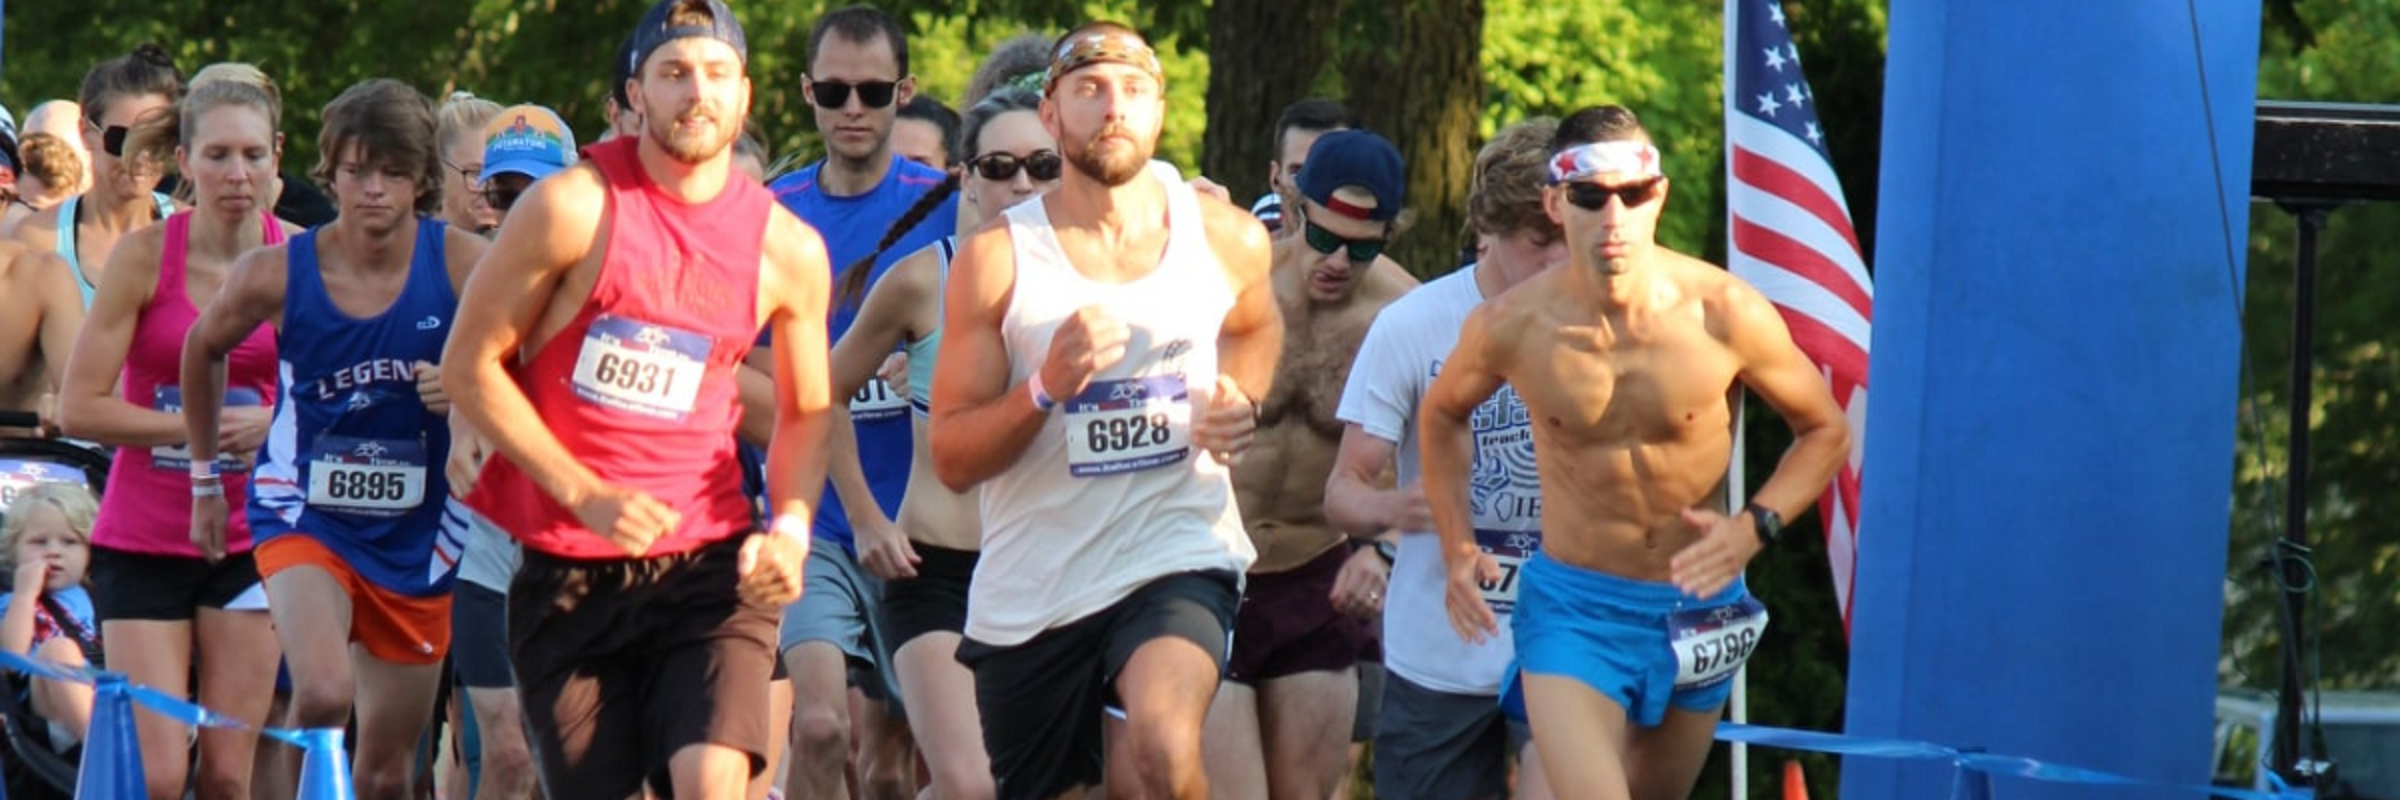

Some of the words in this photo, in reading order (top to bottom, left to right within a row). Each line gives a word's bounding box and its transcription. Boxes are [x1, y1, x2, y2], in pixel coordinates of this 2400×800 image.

[317, 358, 416, 400] LEGEN
[596, 353, 675, 397] 6931
[1087, 413, 1171, 453] 6928
[328, 469, 406, 501] 6895
